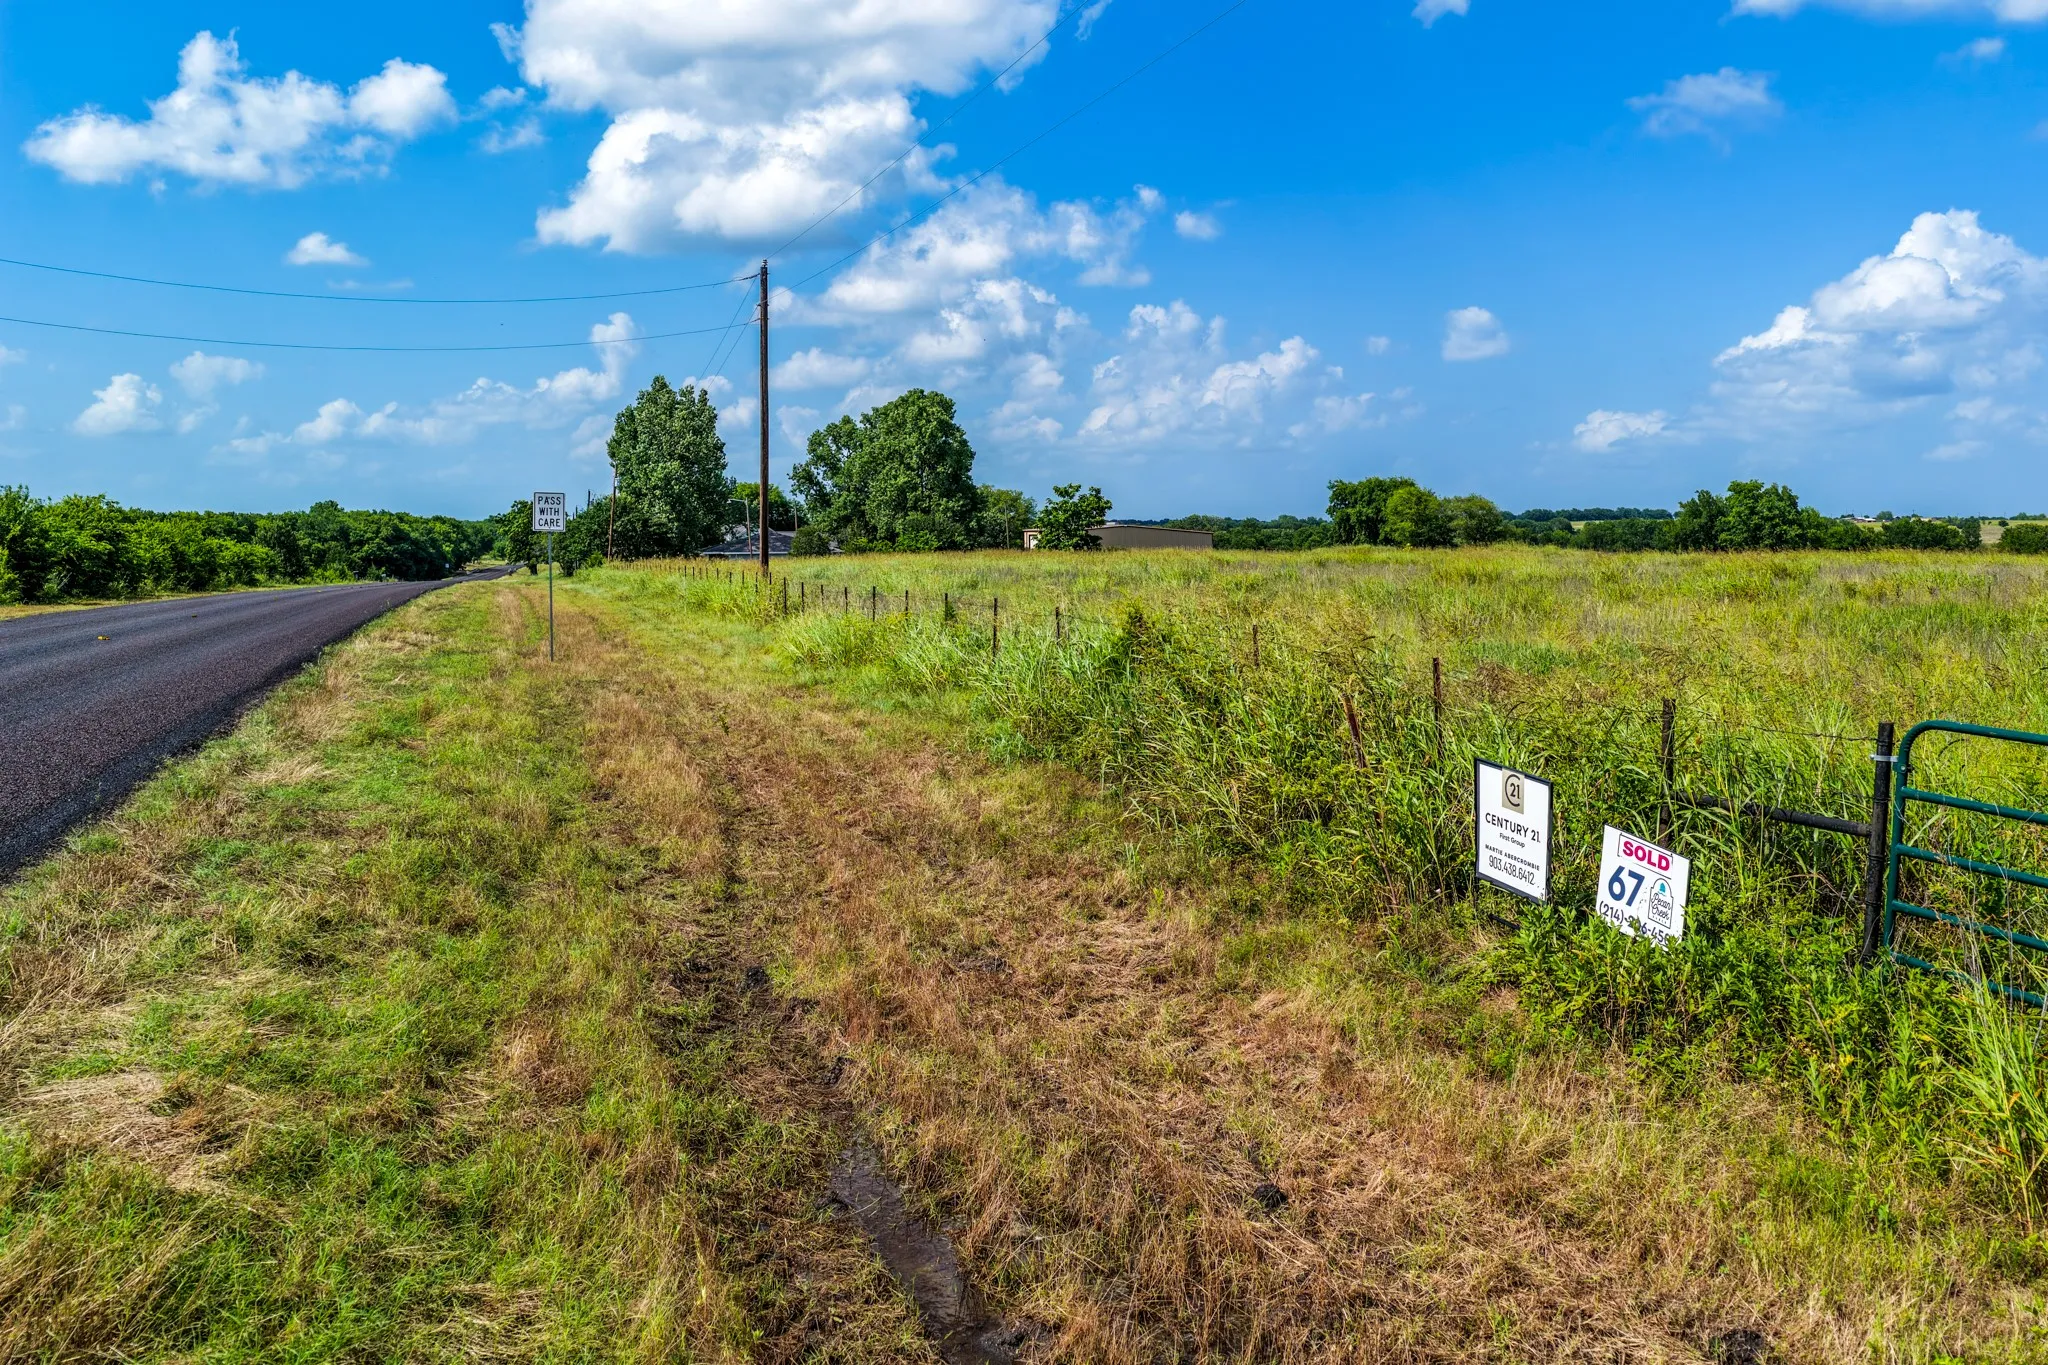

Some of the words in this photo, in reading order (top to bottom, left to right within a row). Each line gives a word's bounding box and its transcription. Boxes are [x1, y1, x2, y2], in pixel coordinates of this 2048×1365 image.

[538, 496, 561, 505] PASS
[539, 507, 559, 516] WITH
[538, 518, 560, 527] CARE
[1485, 812, 1529, 838] CENTURY
[1530, 829, 1541, 843] 21
[1499, 832, 1510, 843] First
[1510, 836, 1526, 849] Group
[1485, 843, 1503, 856] MARTIE
[1504, 851, 1540, 871] ABERCROMBIE
[1623, 840, 1670, 871] SOLD
[1489, 854, 1535, 886] 903.438.6412
[1608, 865, 1645, 907] 67
[1651, 892, 1671, 911] Pecan
